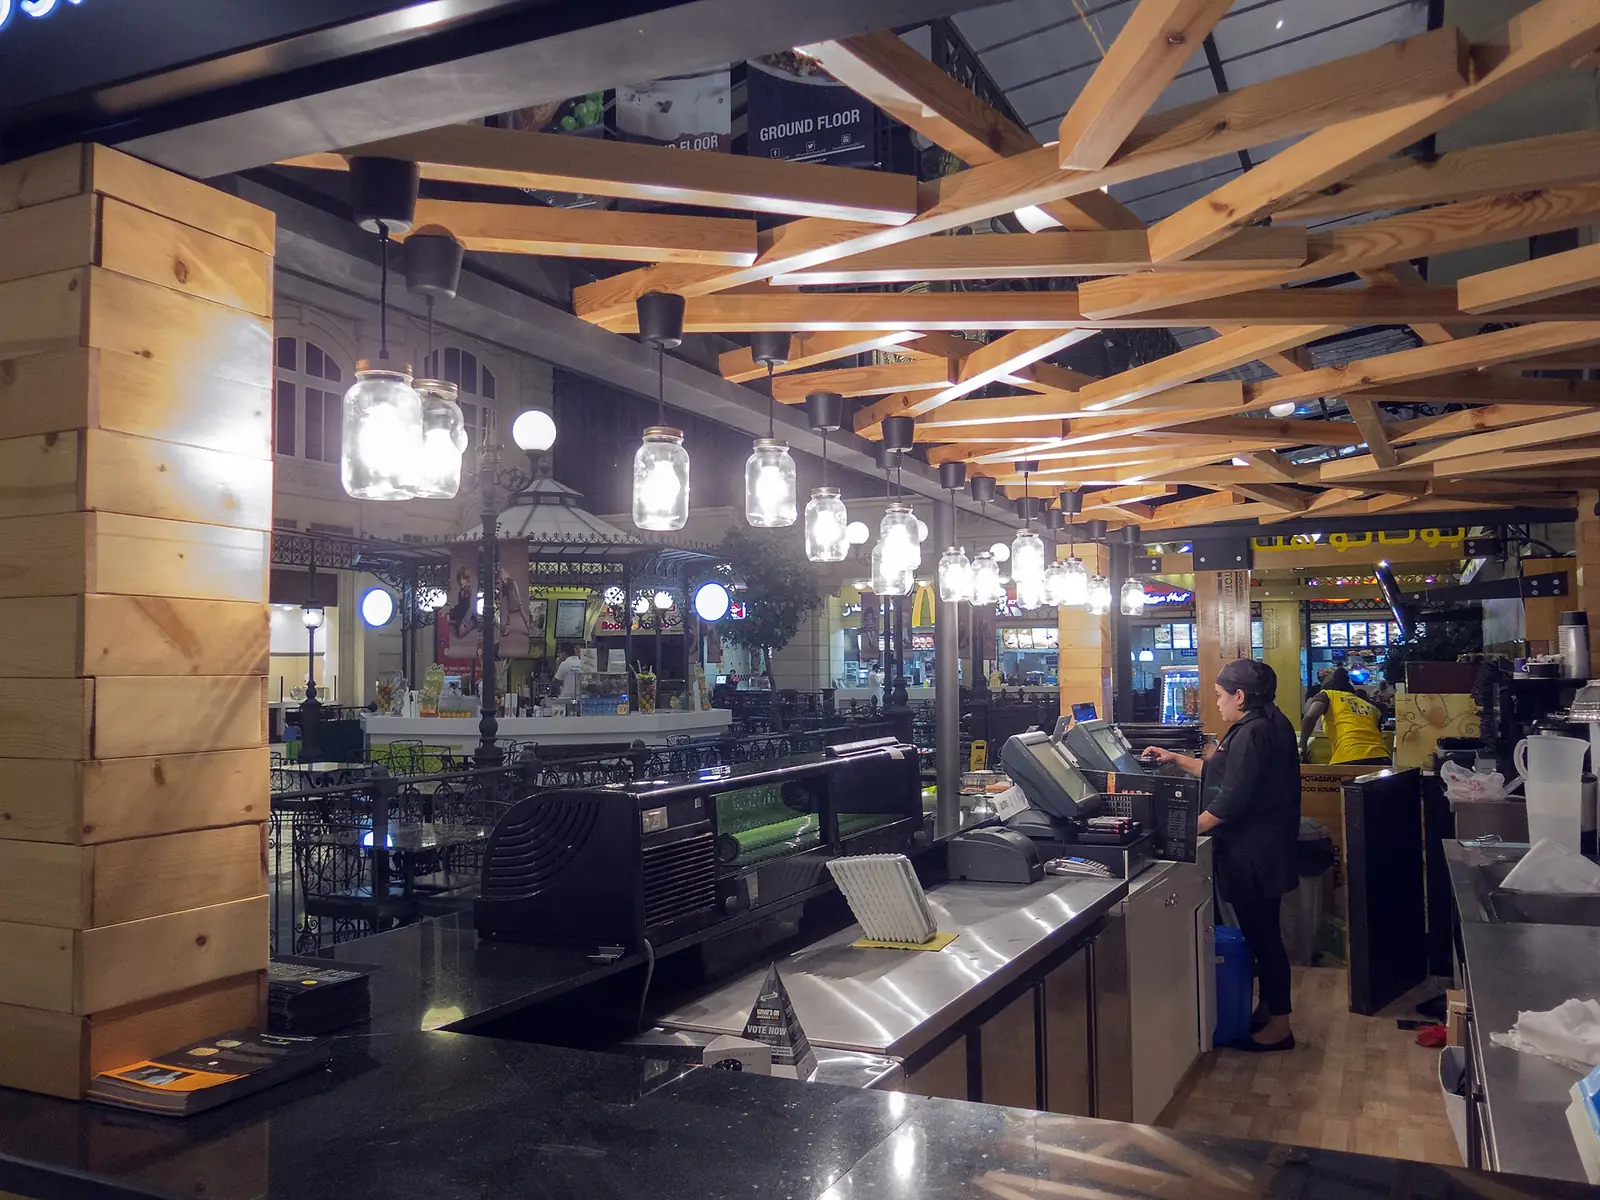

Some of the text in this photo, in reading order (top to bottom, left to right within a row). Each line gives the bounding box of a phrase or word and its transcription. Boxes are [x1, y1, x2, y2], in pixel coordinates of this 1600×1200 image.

[760, 108, 860, 142] GROUND FLOOR
[680, 134, 718, 151] FLOOR
[747, 1025, 787, 1035] VOTE NOW
